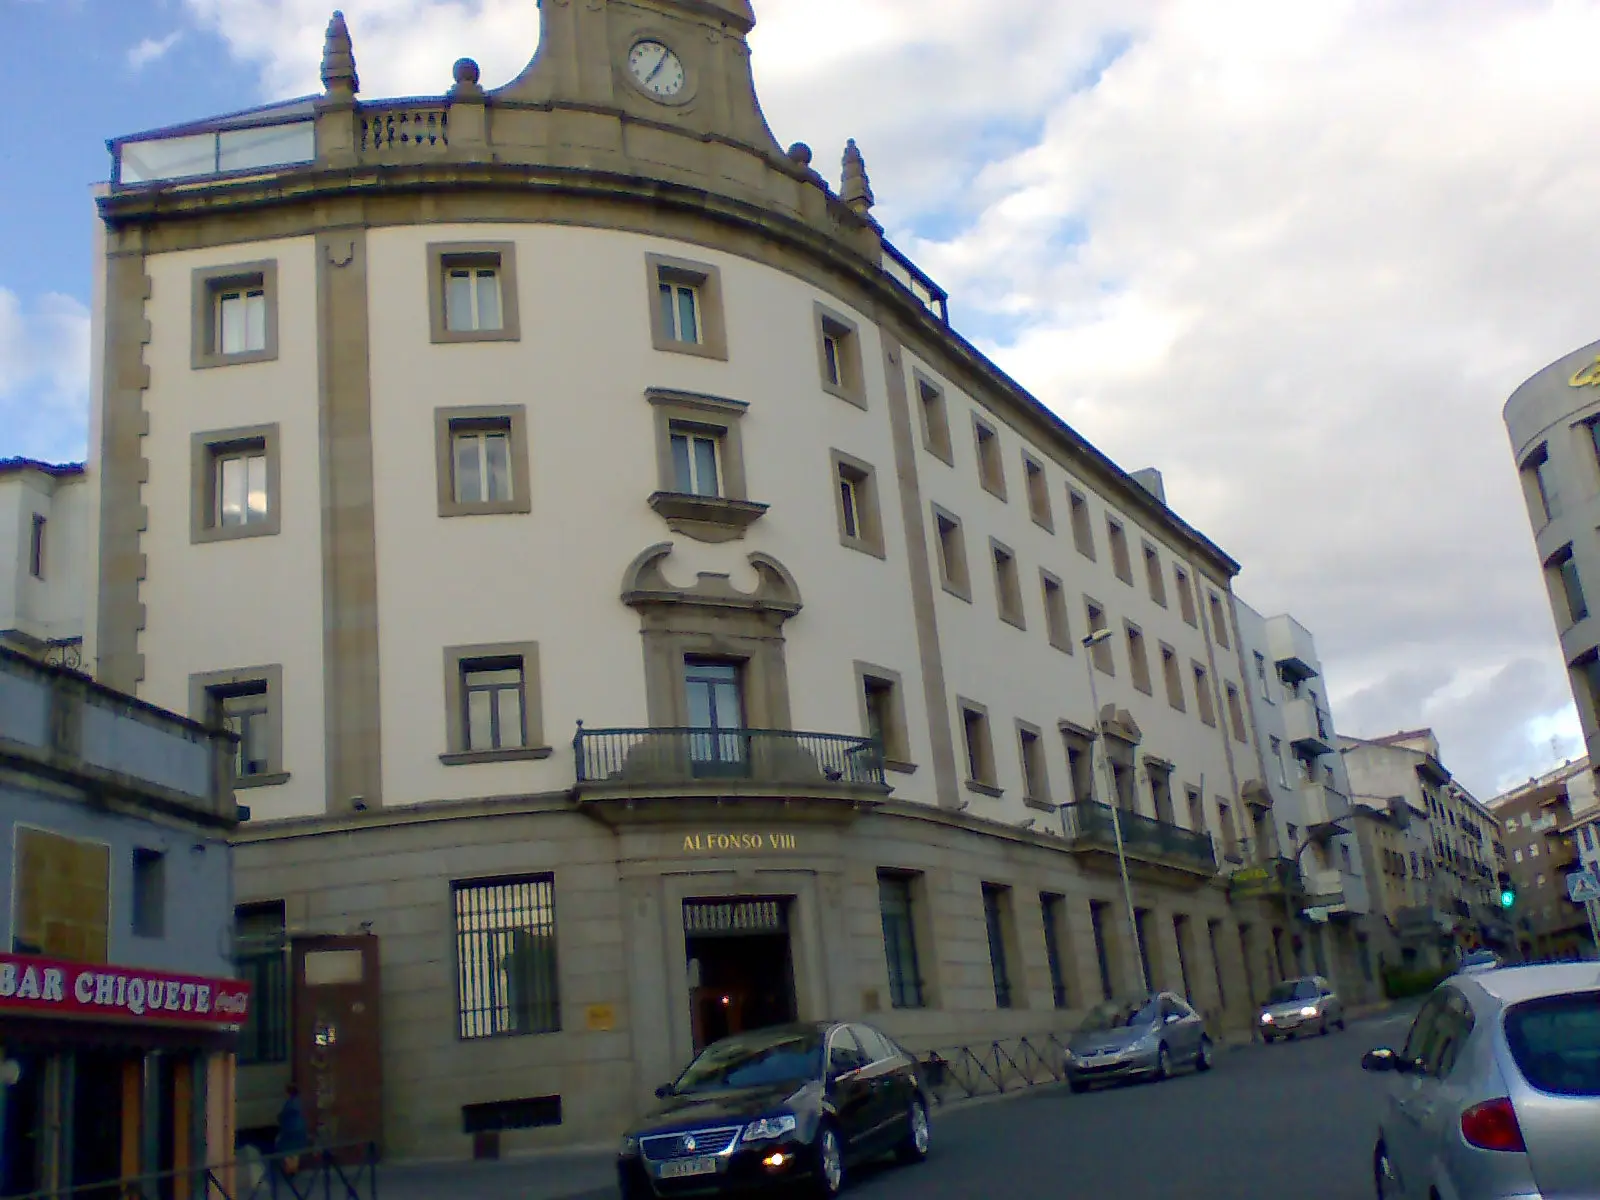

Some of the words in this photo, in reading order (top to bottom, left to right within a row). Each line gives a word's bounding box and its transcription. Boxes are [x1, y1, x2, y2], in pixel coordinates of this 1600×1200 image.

[683, 833, 763, 850] ALFONSO
[769, 833, 796, 849] VIII
[0, 962, 64, 1001] BAR
[74, 971, 210, 1014] CHIQUETE
